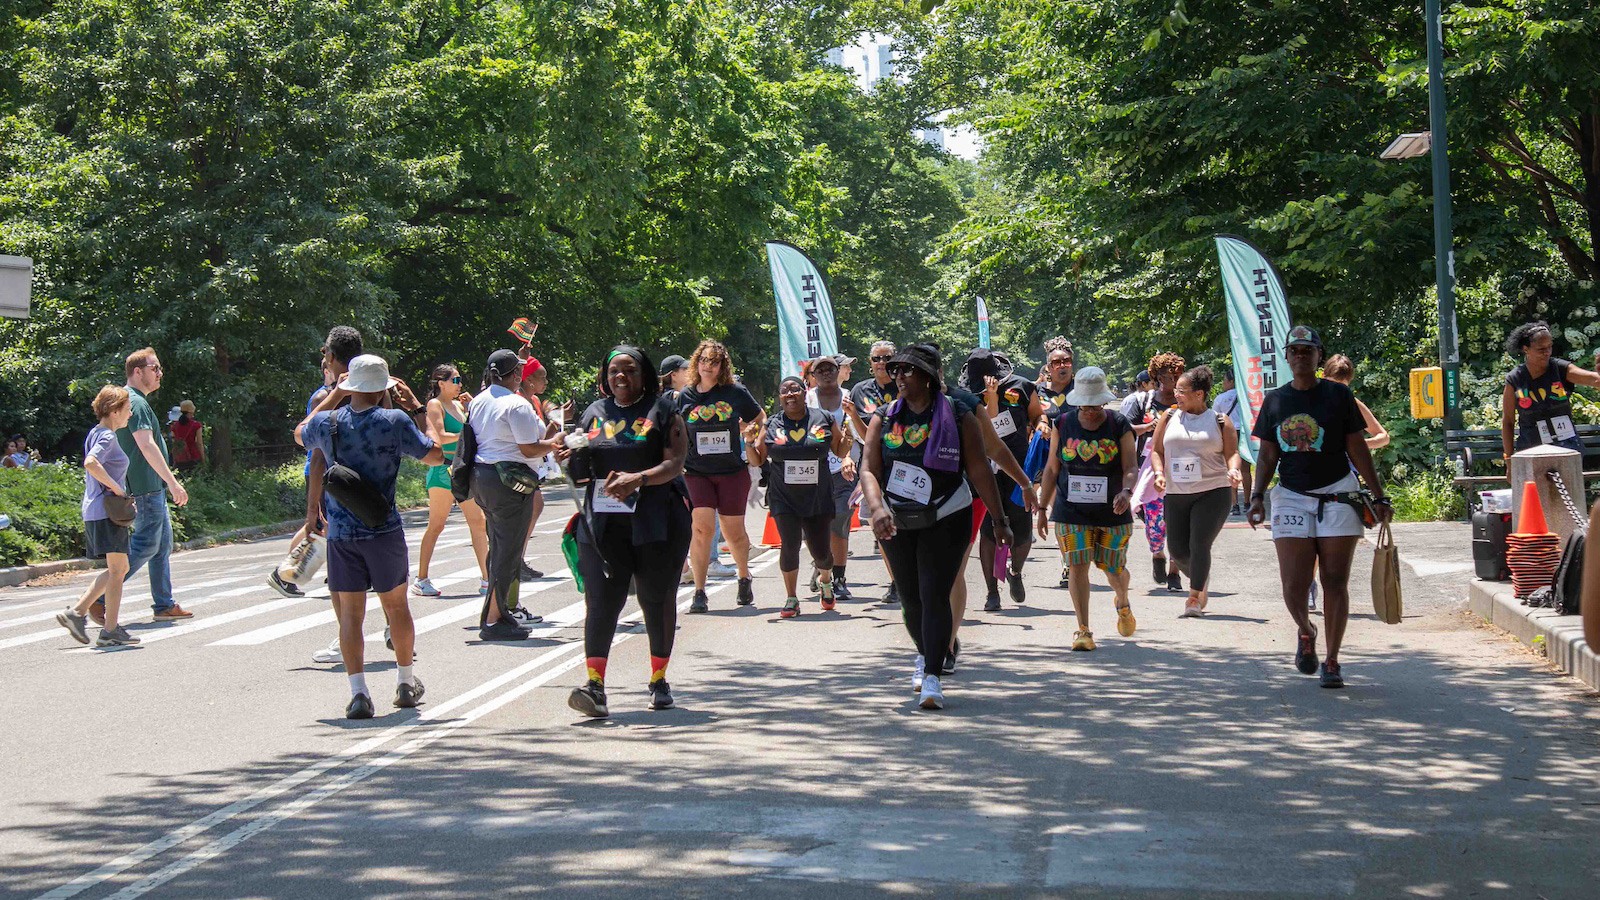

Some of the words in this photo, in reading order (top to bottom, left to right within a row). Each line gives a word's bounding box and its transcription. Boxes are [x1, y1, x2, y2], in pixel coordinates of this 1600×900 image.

[993, 417, 1010, 430] 348
[1557, 421, 1566, 430] 41
[712, 436, 726, 445] 194
[798, 466, 815, 475] 345
[1184, 463, 1195, 472] 47
[911, 476, 927, 489] 45
[1084, 483, 1103, 493] 337
[1283, 514, 1304, 526] 332
